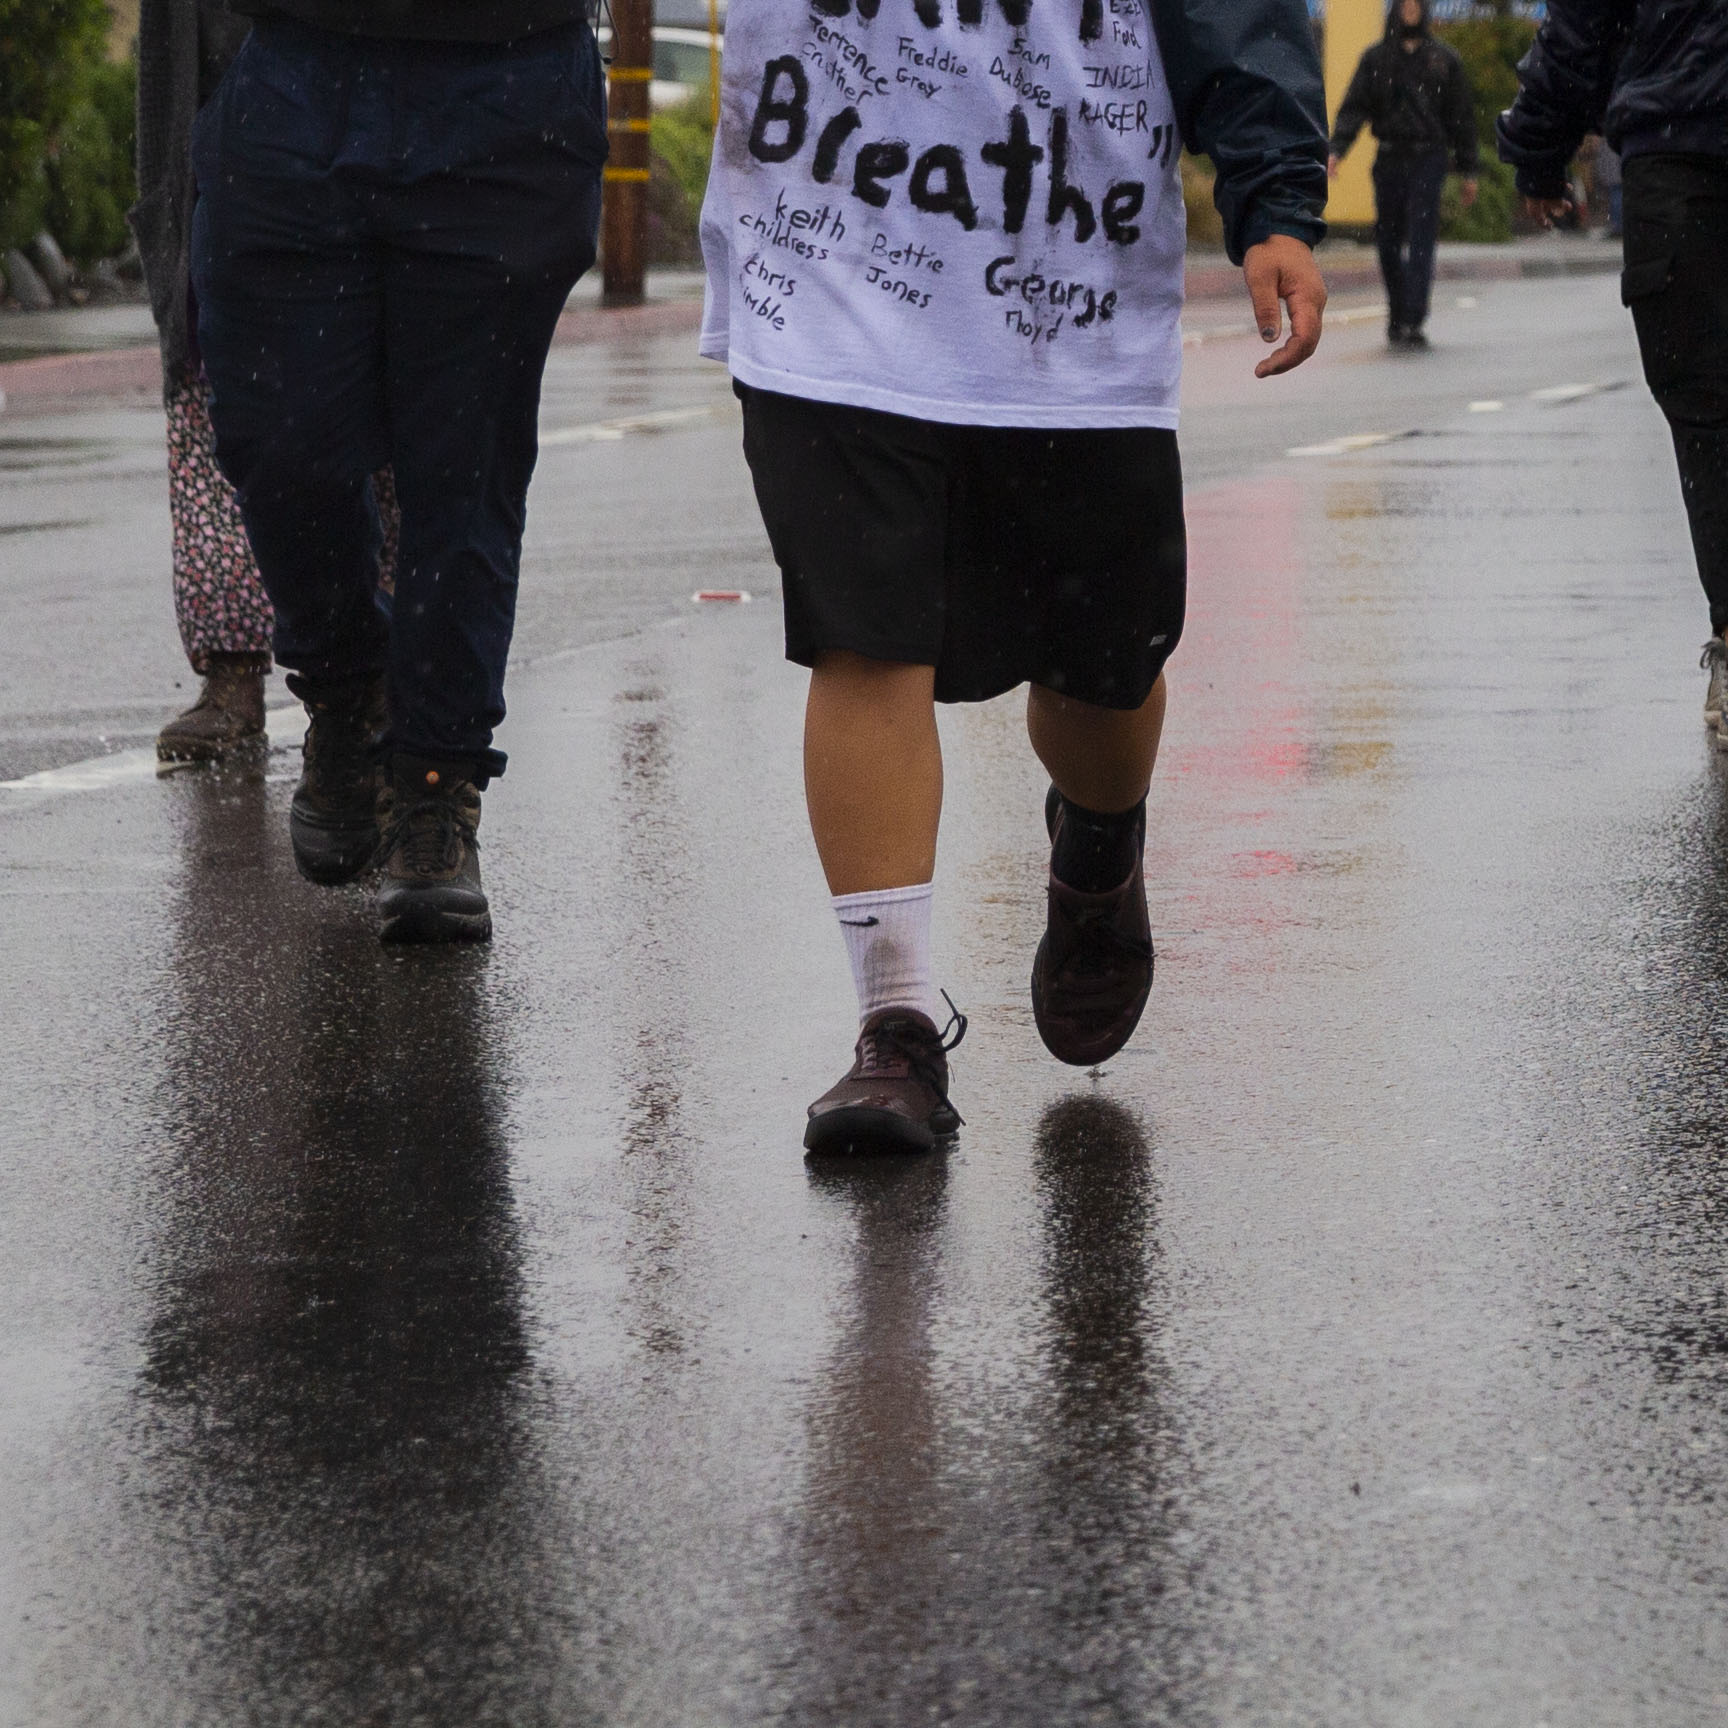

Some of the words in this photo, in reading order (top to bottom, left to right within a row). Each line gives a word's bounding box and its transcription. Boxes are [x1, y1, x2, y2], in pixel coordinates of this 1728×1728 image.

[898, 35, 969, 78] Freddie
[1008, 37, 1051, 70] Sam
[895, 67, 943, 100] Gray
[871, 232, 945, 274] Bettie
[741, 284, 786, 332] imble
[866, 266, 934, 309] Jones
[985, 255, 1119, 329] George
